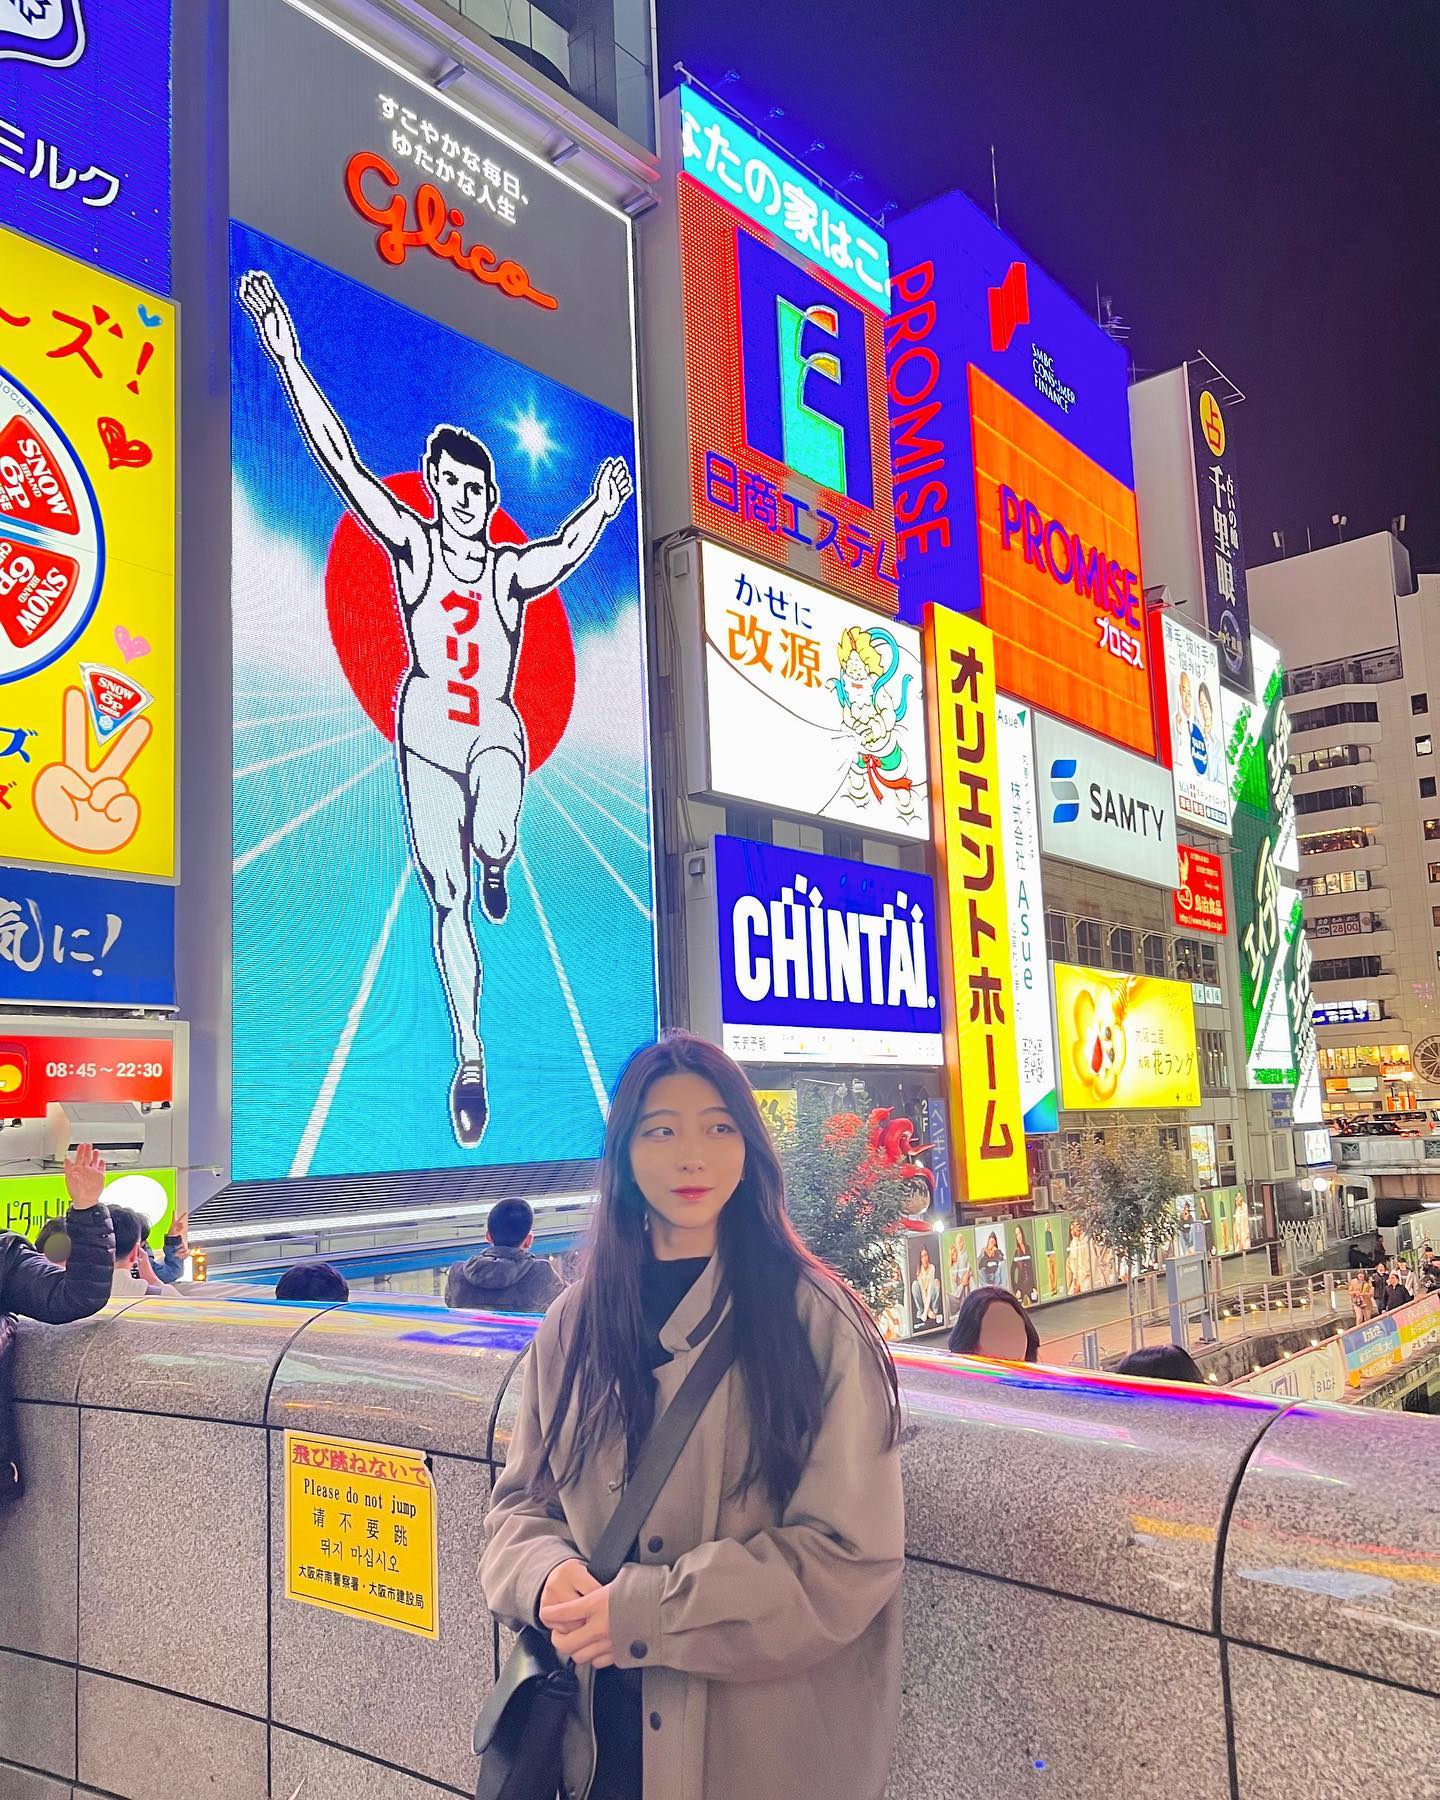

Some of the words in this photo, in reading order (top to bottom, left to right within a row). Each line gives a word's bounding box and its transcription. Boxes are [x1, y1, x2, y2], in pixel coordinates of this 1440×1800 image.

[378, 93, 529, 205] すこやかな毎日、
[392, 129, 517, 225] ゆたかな人生
[344, 151, 559, 310] Glico
[1031, 342, 1055, 373] SMBC
[884, 260, 951, 563] PROMISE
[17, 438, 72, 517] SNOW
[999, 483, 1141, 630] PROMISE
[16, 567, 69, 637] SNOW
[440, 590, 482, 727] グリコ
[725, 608, 823, 689] 改源
[1096, 616, 1144, 669] プロミス
[98, 677, 136, 701] SNOW
[997, 709, 1018, 729] Asue
[1089, 782, 1165, 842] SAMTY
[949, 645, 1014, 1161] オリエントホーム
[1018, 879, 1033, 991] Asue
[292, 1443, 428, 1486] 飛び跳ねないで
[303, 1477, 341, 1501] Please
[346, 1485, 359, 1504] do
[364, 1493, 383, 1510] not
[390, 1495, 417, 1518] jump
[350, 1545, 400, 1573] 마십시오
